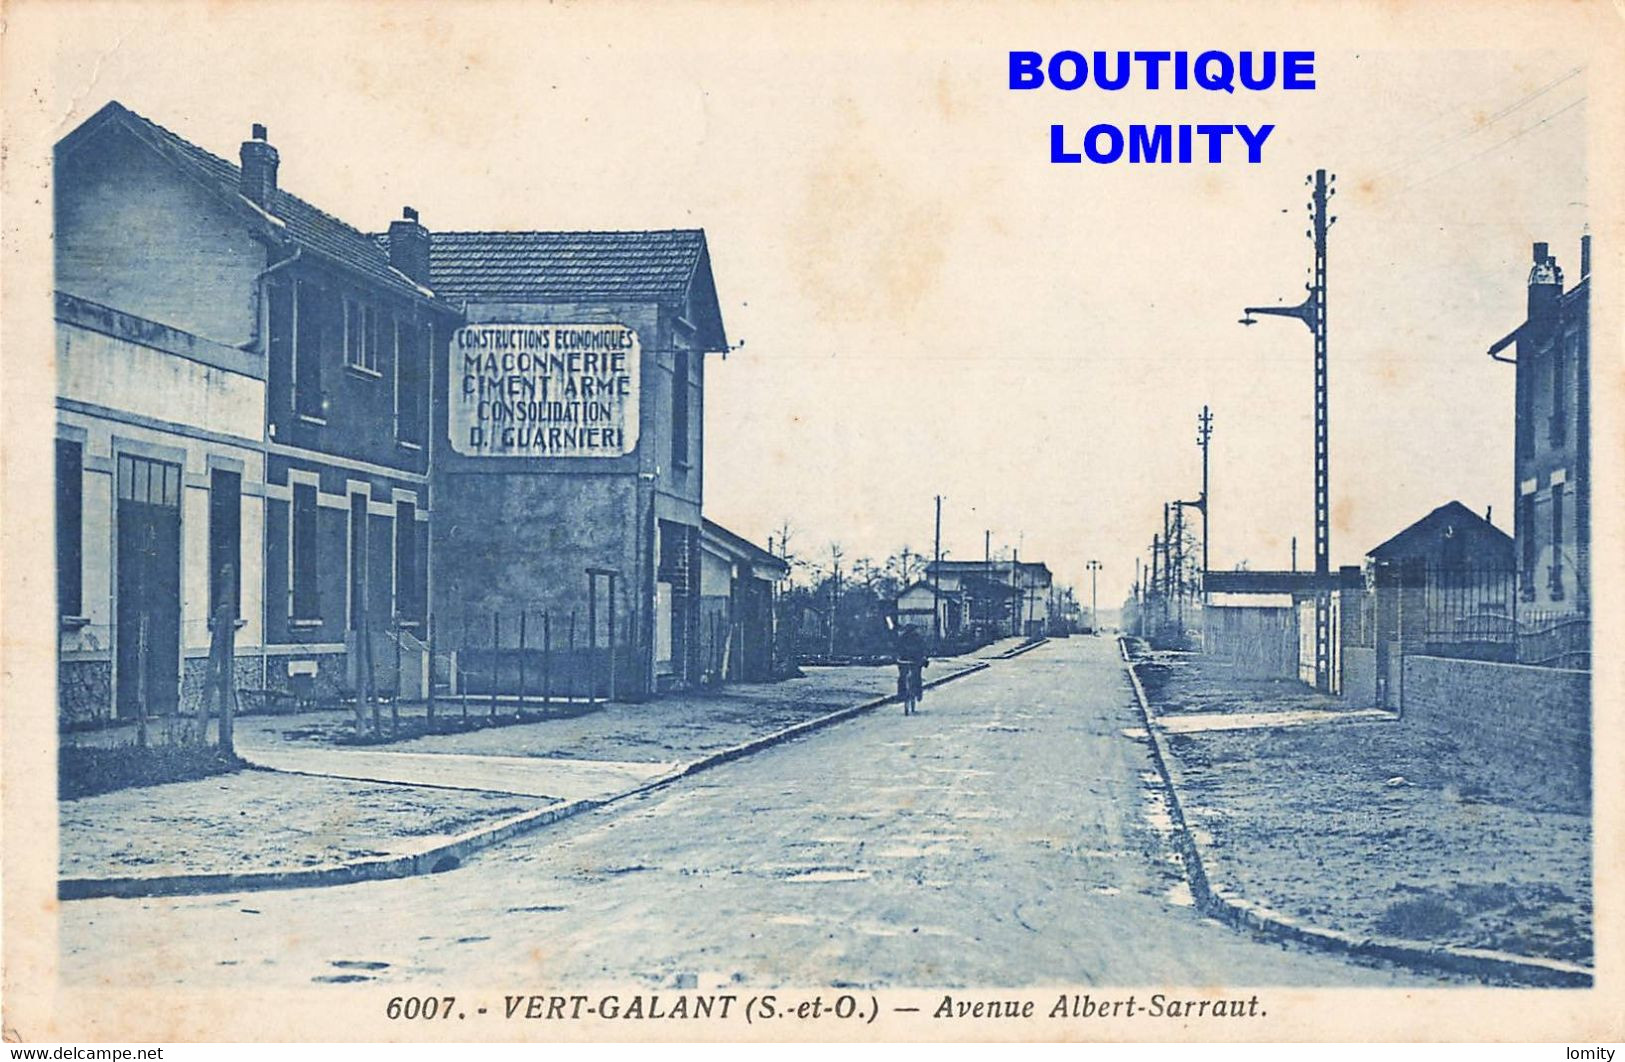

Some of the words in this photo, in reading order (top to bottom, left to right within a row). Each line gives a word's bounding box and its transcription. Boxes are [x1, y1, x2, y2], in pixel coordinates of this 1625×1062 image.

[458, 329, 550, 349] CONSTRUCTIONS
[464, 352, 625, 374] MACONNERIE
[463, 375, 552, 398] CIMENT
[565, 376, 630, 398] ARME
[478, 400, 612, 423] CONSOLIDATION
[470, 427, 488, 448] D.
[502, 427, 623, 449] GUARNIERI
